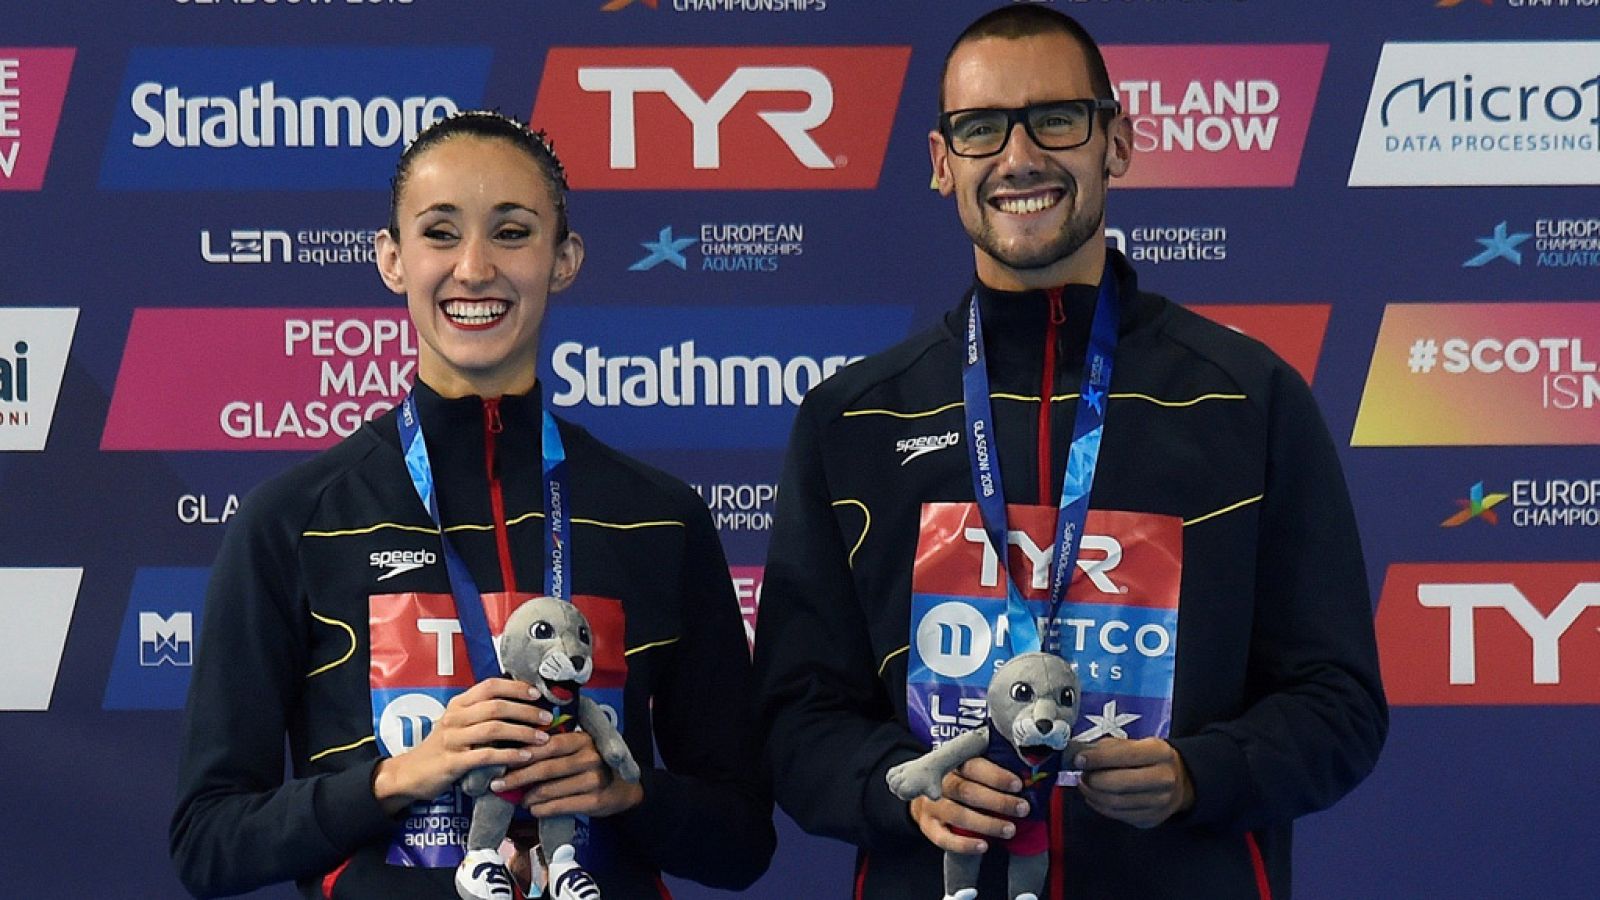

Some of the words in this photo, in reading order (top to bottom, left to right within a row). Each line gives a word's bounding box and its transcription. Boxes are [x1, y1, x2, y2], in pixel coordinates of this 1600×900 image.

[1111, 80, 1280, 116] TLAND
[578, 66, 834, 170] TYR
[1385, 134, 1442, 153] DATA
[1451, 134, 1593, 152] PROCESSING
[297, 229, 377, 247] europea
[701, 224, 803, 243] EUROPEAN
[1130, 226, 1227, 245] european
[1535, 219, 1600, 238] EUROP
[297, 244, 378, 267] aquatic
[701, 242, 803, 256] CHAMPIONSHIPS
[1131, 241, 1227, 265] aquatics
[702, 255, 779, 272] AQUATICS
[285, 319, 418, 357] PEOPL
[1408, 337, 1600, 374] #SCOTL
[319, 360, 416, 397] MAK
[552, 339, 866, 408] Strathmor
[896, 430, 960, 453] speedo
[973, 419, 991, 472] GLASGOW
[1511, 479, 1600, 506] EUROP
[1512, 507, 1600, 527] CHAMPIO
[369, 547, 437, 569] speedo
[963, 527, 1122, 594] TYR
[1417, 582, 1600, 685] TY
[930, 694, 992, 727] LE
[404, 815, 470, 832] europea
[403, 828, 470, 850] aquatic
